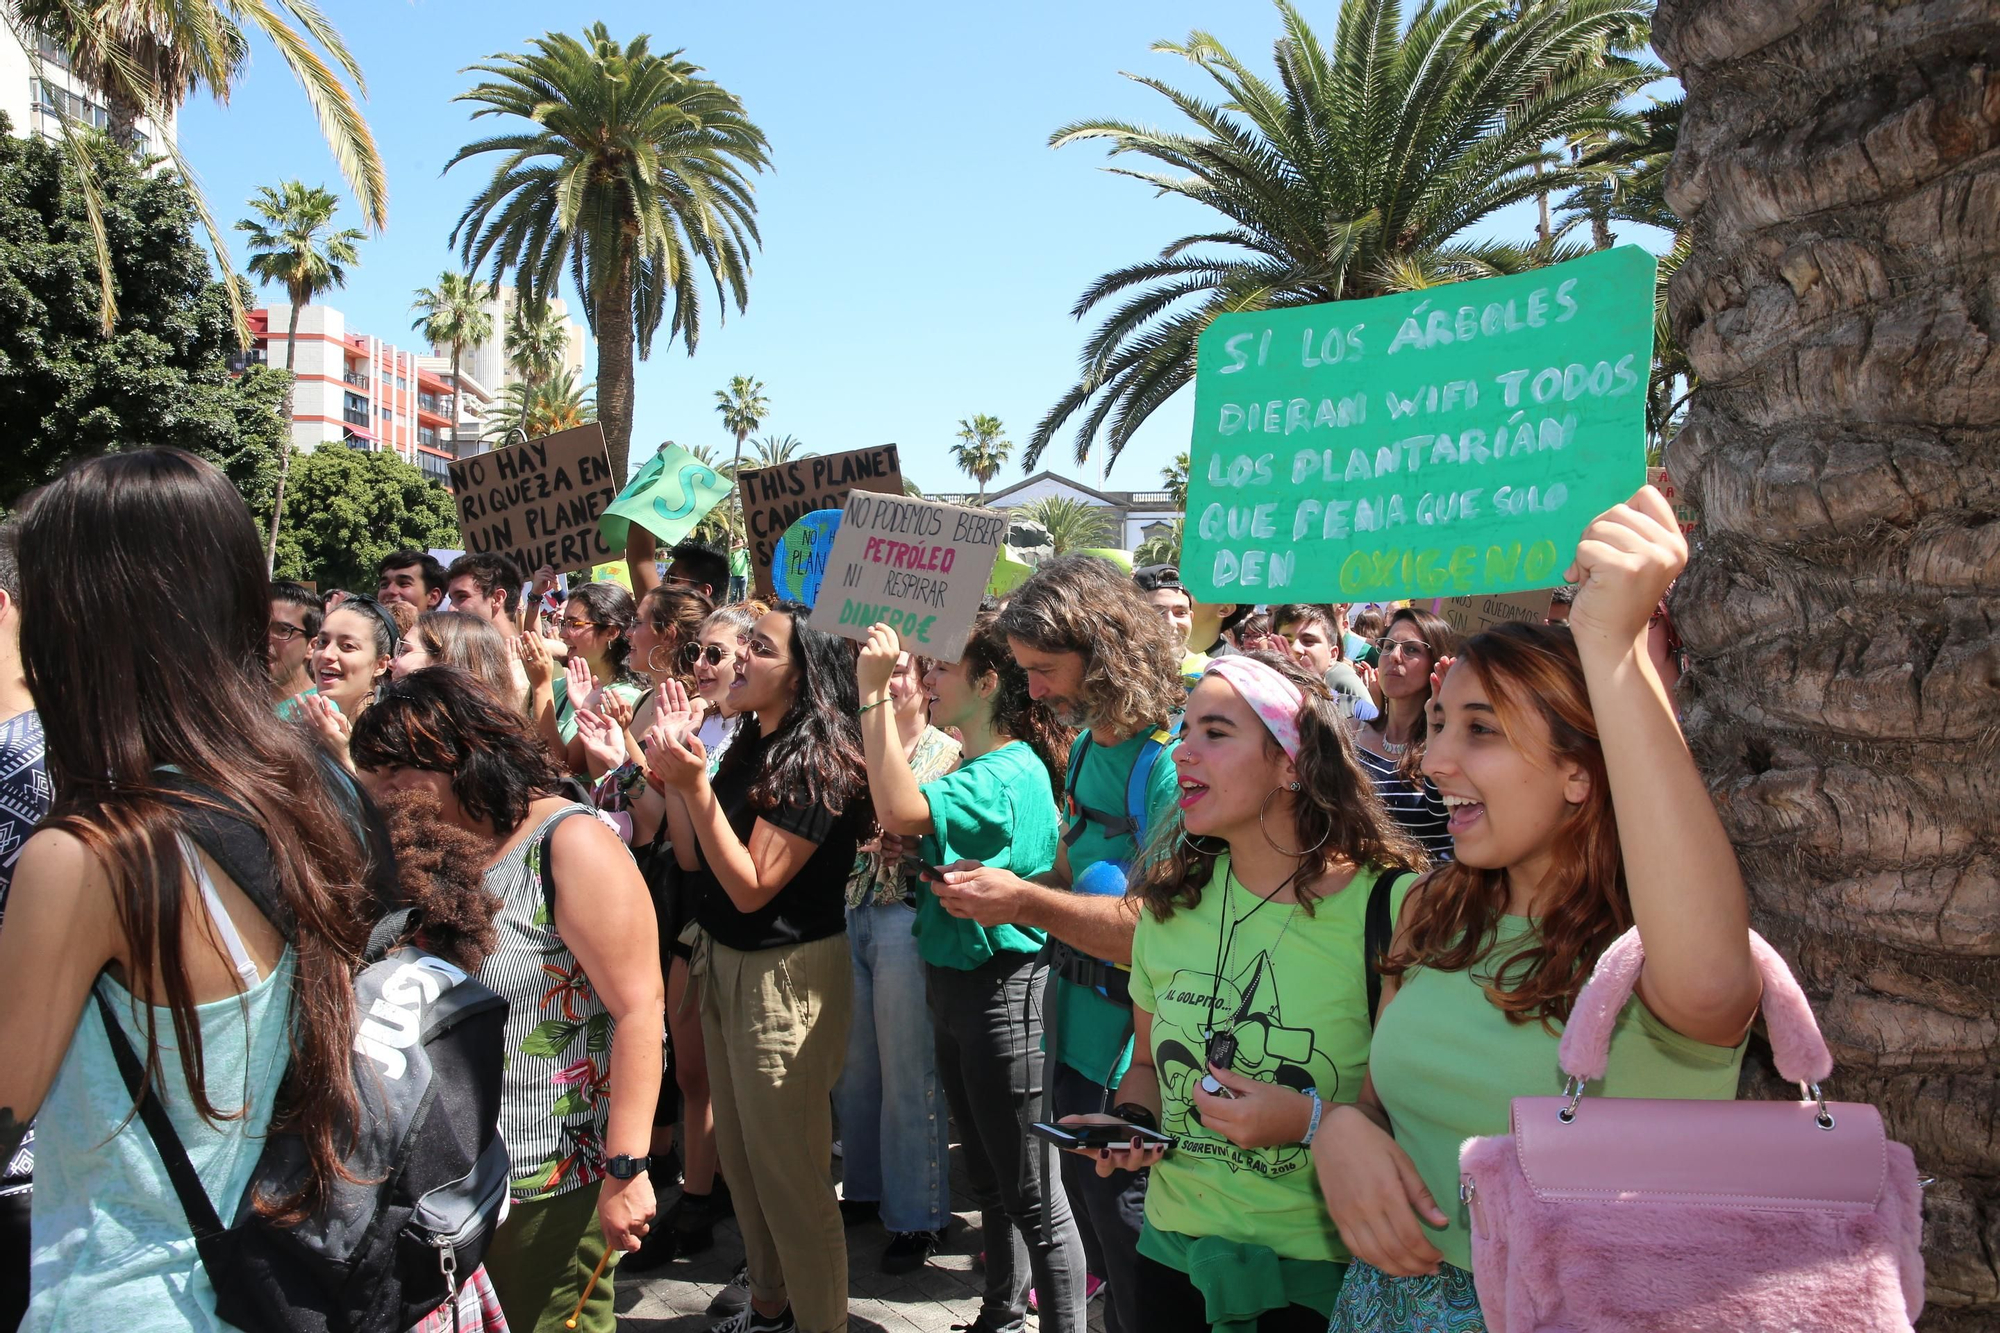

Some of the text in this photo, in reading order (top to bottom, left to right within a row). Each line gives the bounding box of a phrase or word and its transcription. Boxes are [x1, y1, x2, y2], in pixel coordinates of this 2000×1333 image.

[1219, 278, 1578, 374] SI LOS ÁRBOLES
[1218, 354, 1639, 435] DIERAN WIFI TODOS
[450, 441, 547, 495] NO HAY
[1208, 410, 1577, 489] LOS PLANTARIÁN
[462, 467, 573, 523] RIQUEZA
[578, 451, 610, 485] EN
[740, 446, 897, 505] THIS PLANET
[470, 517, 513, 554] UN
[844, 496, 1004, 548] NO PODEMOS BEBER
[1199, 482, 1568, 542] QUE PENA QUE SOLO
[802, 530, 817, 546] NO
[863, 536, 956, 575] PETRÓLEO
[843, 563, 948, 609] NI RESPIRAR
[1212, 549, 1295, 588] DEN
[1447, 610, 1468, 632] SIN
[1164, 990, 1176, 1000] AL
[1232, 1151, 1243, 1164] AL
[1246, 1156, 1268, 1174] RAID
[1271, 1162, 1296, 1175] 2016
